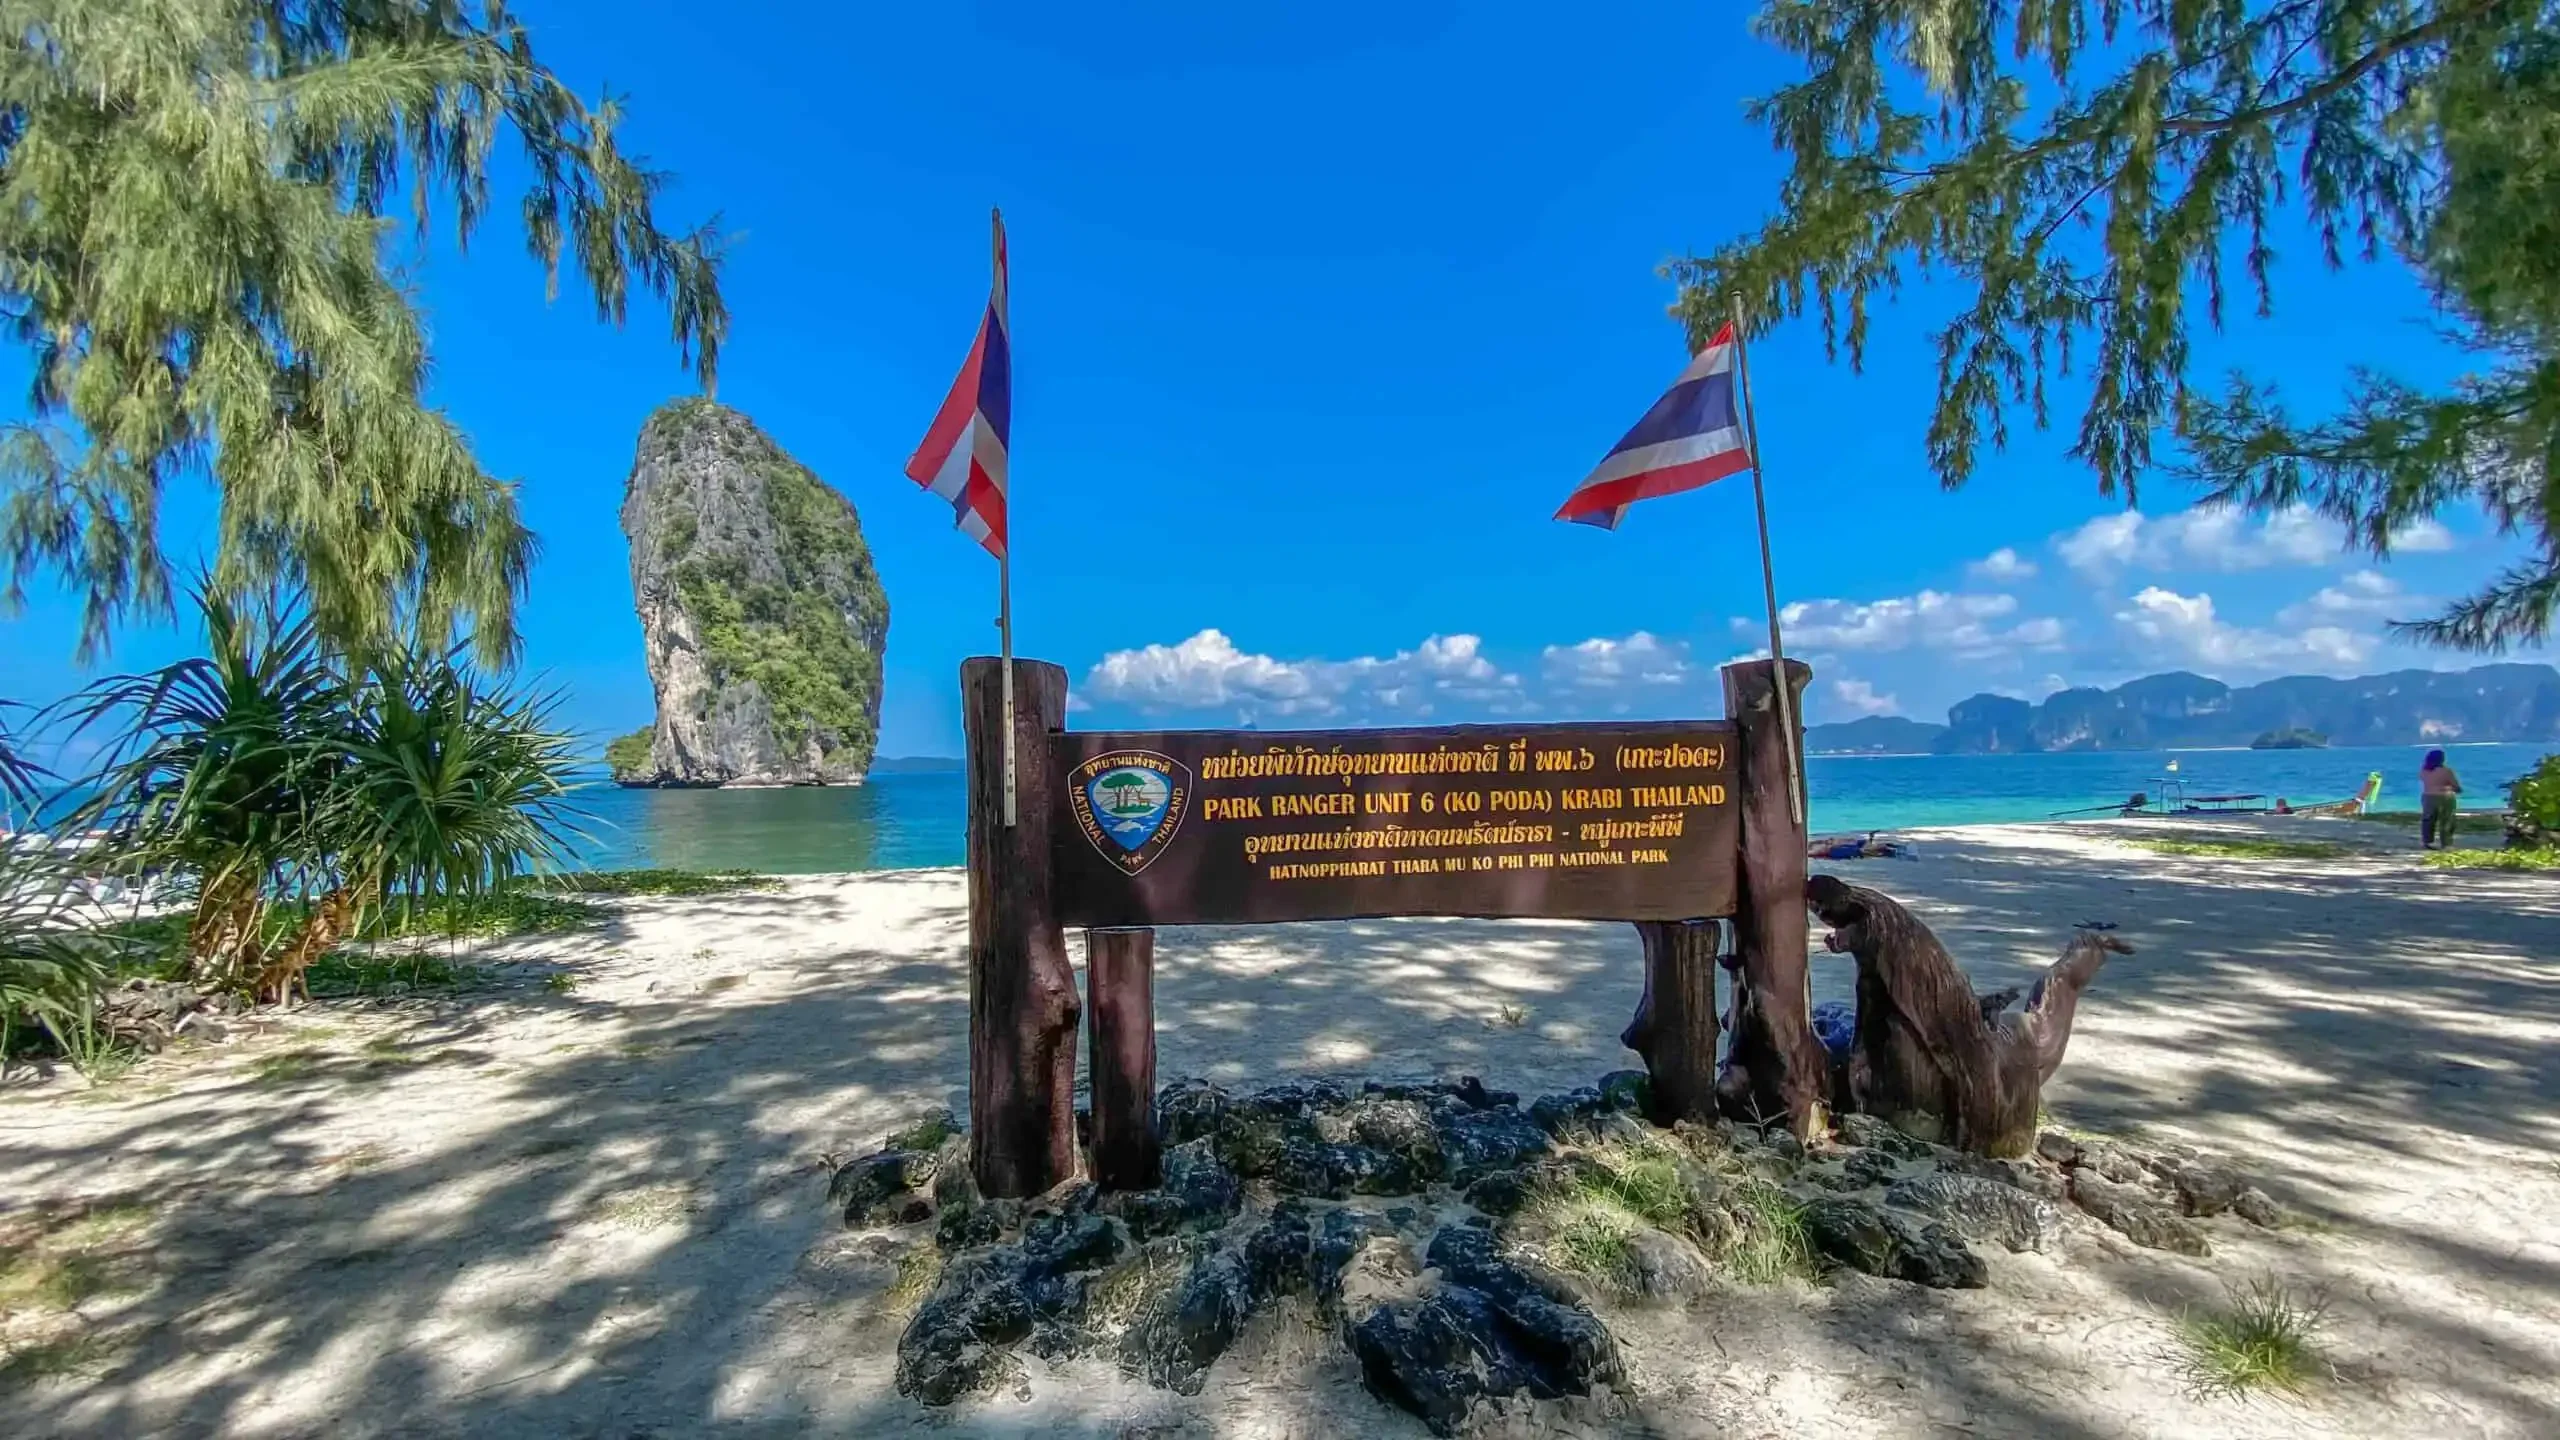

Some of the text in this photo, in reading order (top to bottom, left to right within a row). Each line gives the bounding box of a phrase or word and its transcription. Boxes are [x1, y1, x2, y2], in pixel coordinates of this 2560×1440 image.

[1084, 753, 1172, 777] อุทยานแห่งชาติ
[1508, 737, 1527, 773] ที่
[1072, 785, 1106, 846] NATIONAL
[1151, 787, 1184, 845] THAILAND
[1203, 785, 1725, 820] PARK RANGER UNIT 6 (KO PODA) KRABI THAILAND
[1269, 848, 1669, 880] HATNOPPHARAT THARA MU KO PHI PHI NATIONAL PARK
